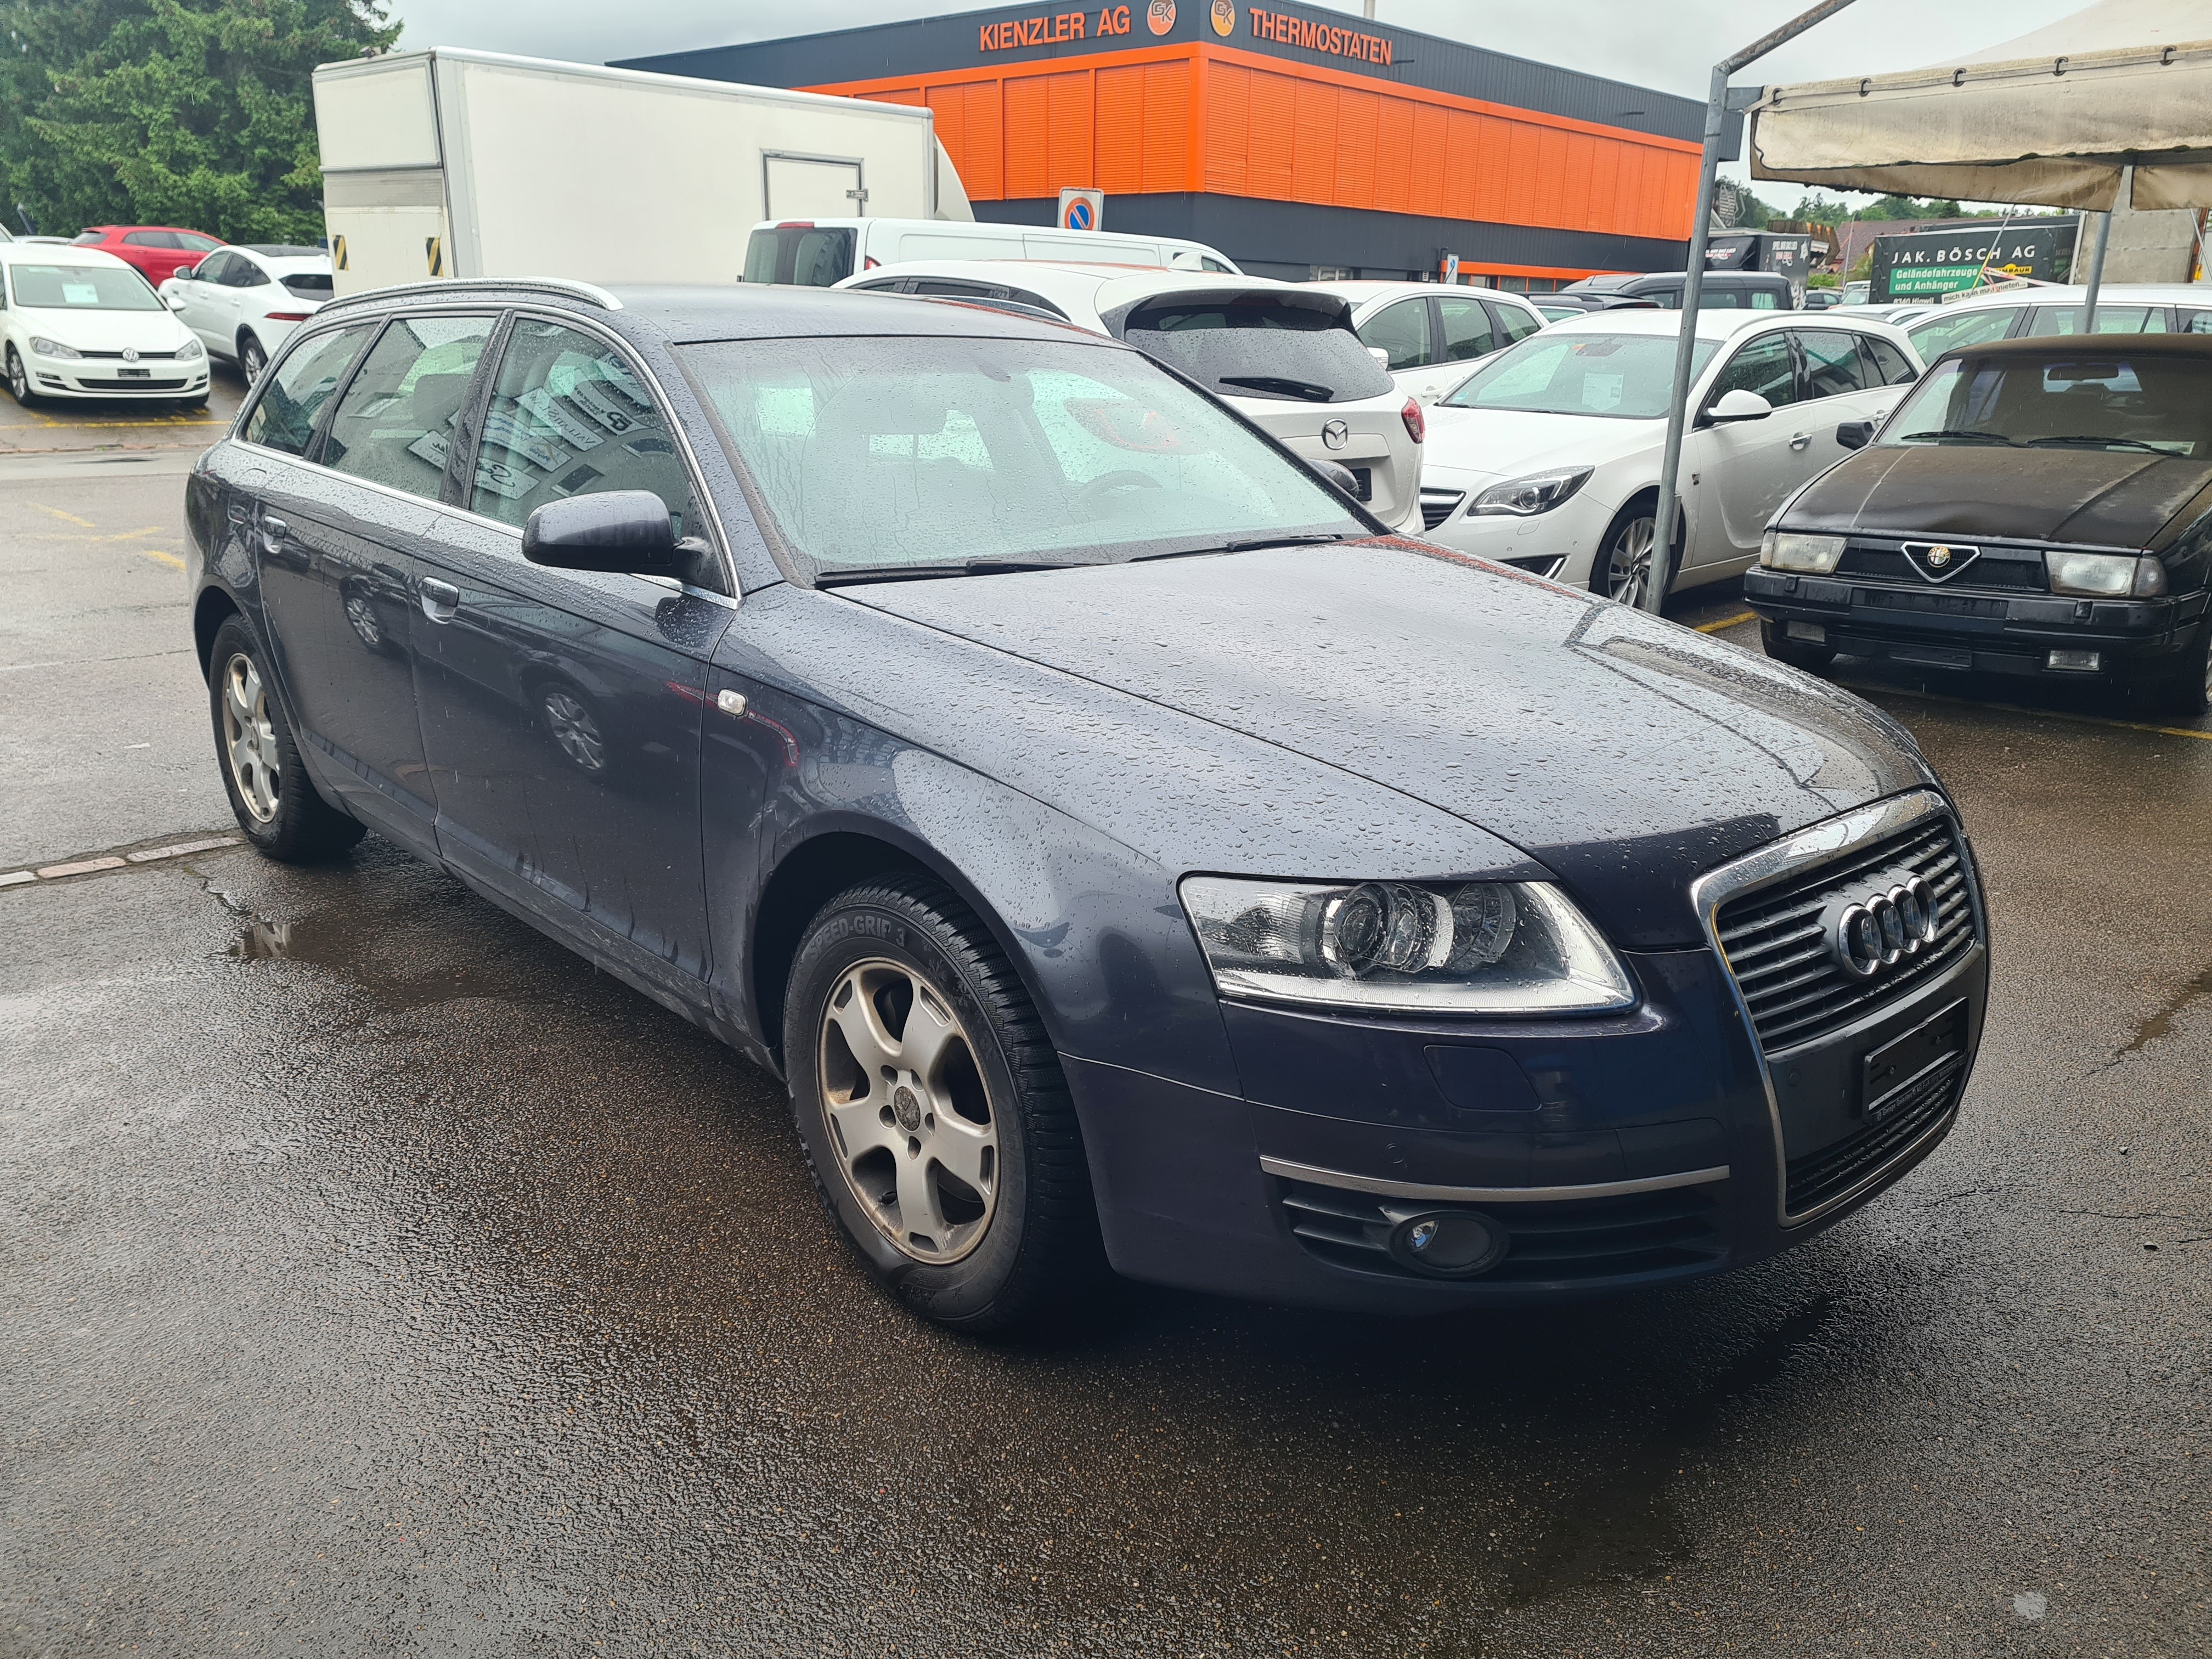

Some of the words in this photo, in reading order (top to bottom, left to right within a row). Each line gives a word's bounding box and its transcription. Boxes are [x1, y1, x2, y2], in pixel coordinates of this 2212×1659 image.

[979, 12, 1085, 52] KIENZLER
[1097, 5, 1131, 37] AG
[1249, 7, 1392, 66] THERMOSTATEN
[1892, 251, 1931, 264] JAK.
[1937, 247, 2001, 262] BÖSCH
[2011, 245, 2035, 258] AG
[1896, 267, 1978, 279] Geländefahrzeuge
[1895, 281, 1912, 291] und
[1914, 280, 1959, 291] Anhänger
[1944, 294, 1960, 302] mich
[806, 915, 891, 960] SPEED-GRIP
[896, 927, 905, 947] 3
